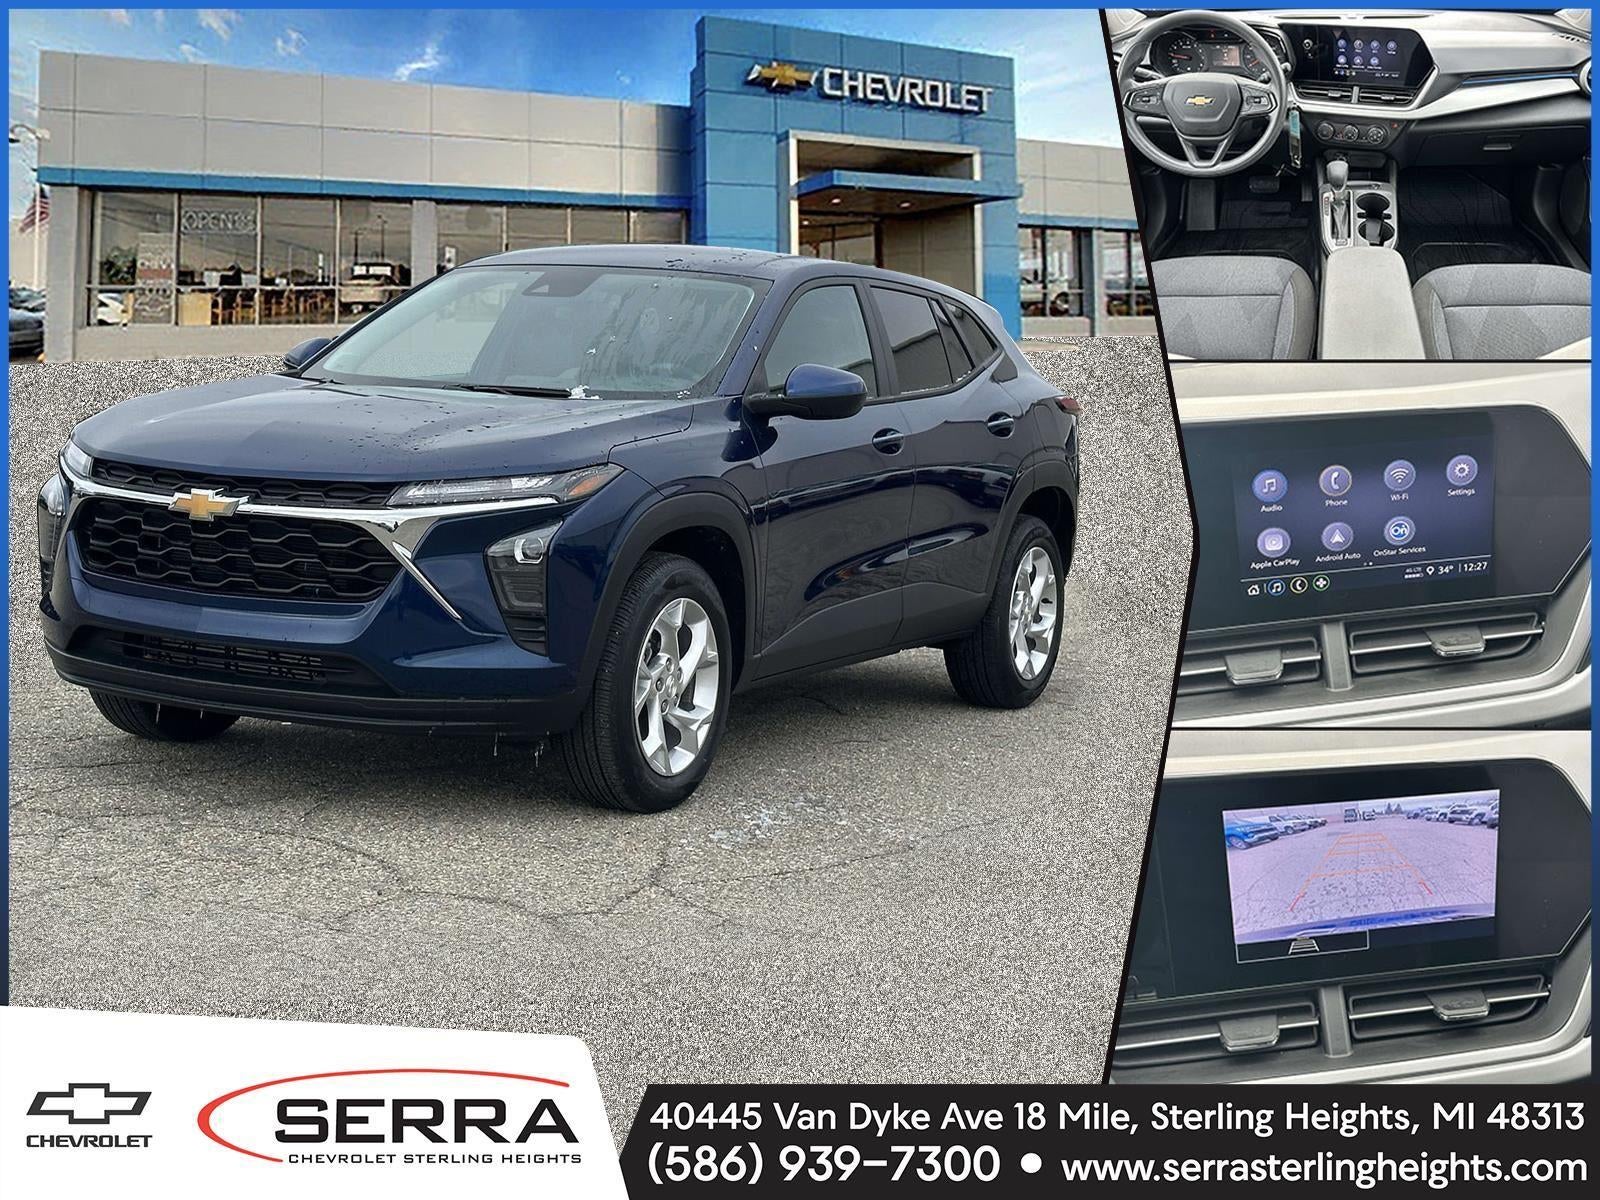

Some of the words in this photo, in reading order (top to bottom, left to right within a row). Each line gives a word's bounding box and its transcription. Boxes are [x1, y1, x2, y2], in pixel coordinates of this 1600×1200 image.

[822, 67, 993, 112] CHEVROLET
[1390, 493, 1409, 502] Wi-Fi
[1447, 487, 1476, 498] Settings
[1325, 498, 1348, 507] Phone
[1260, 504, 1283, 513] Audio
[1315, 553, 1343, 563] Android
[1344, 551, 1361, 561] Auto
[1373, 548, 1398, 557] OnStar
[1399, 546, 1426, 556] Services
[1250, 560, 1272, 570] Apple
[1273, 557, 1301, 569] CarPlay
[1463, 561, 1488, 572] 12:27
[1438, 564, 1454, 575] 34°
